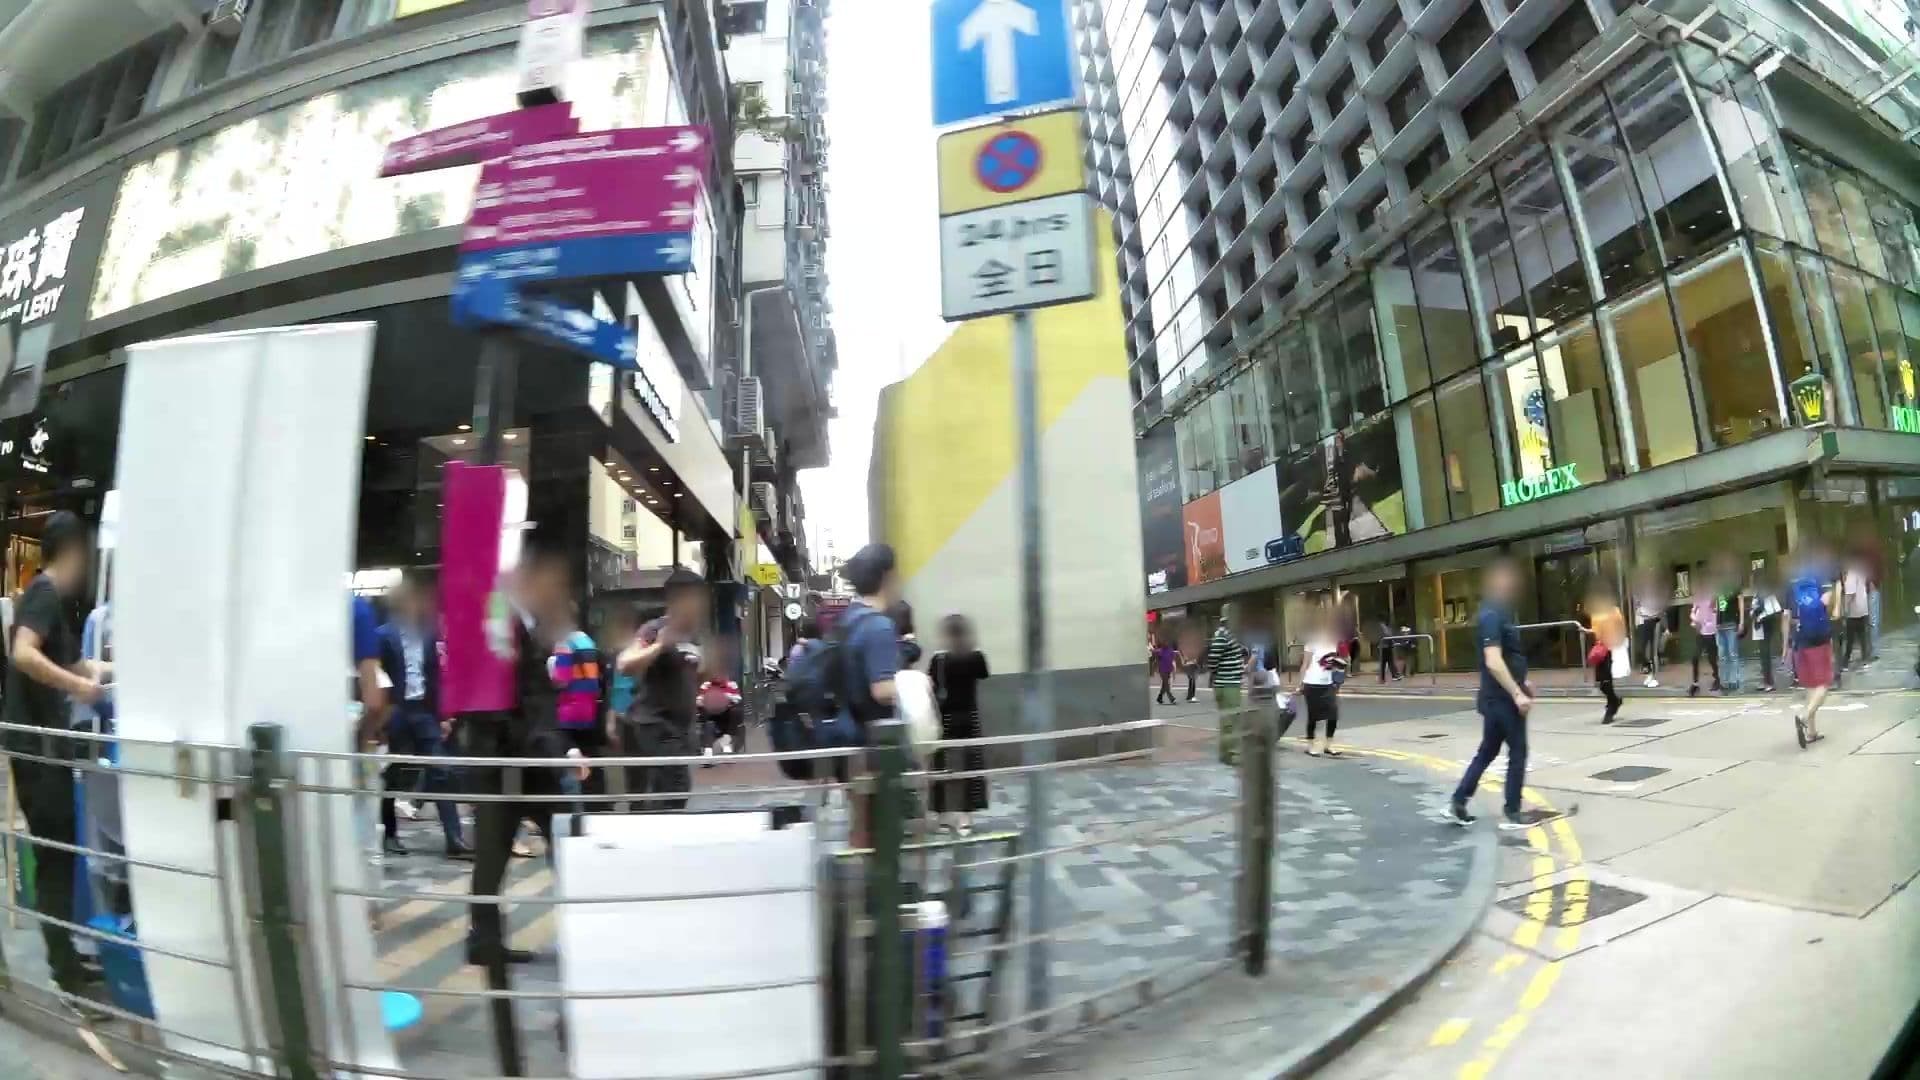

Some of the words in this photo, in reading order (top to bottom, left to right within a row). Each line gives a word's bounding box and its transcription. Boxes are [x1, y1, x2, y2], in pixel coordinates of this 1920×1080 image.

[0, 206, 85, 301] 珠寶
[968, 248, 1063, 299] 全日
[0, 284, 65, 324] LERY
[1501, 462, 1582, 506] ROLEX
